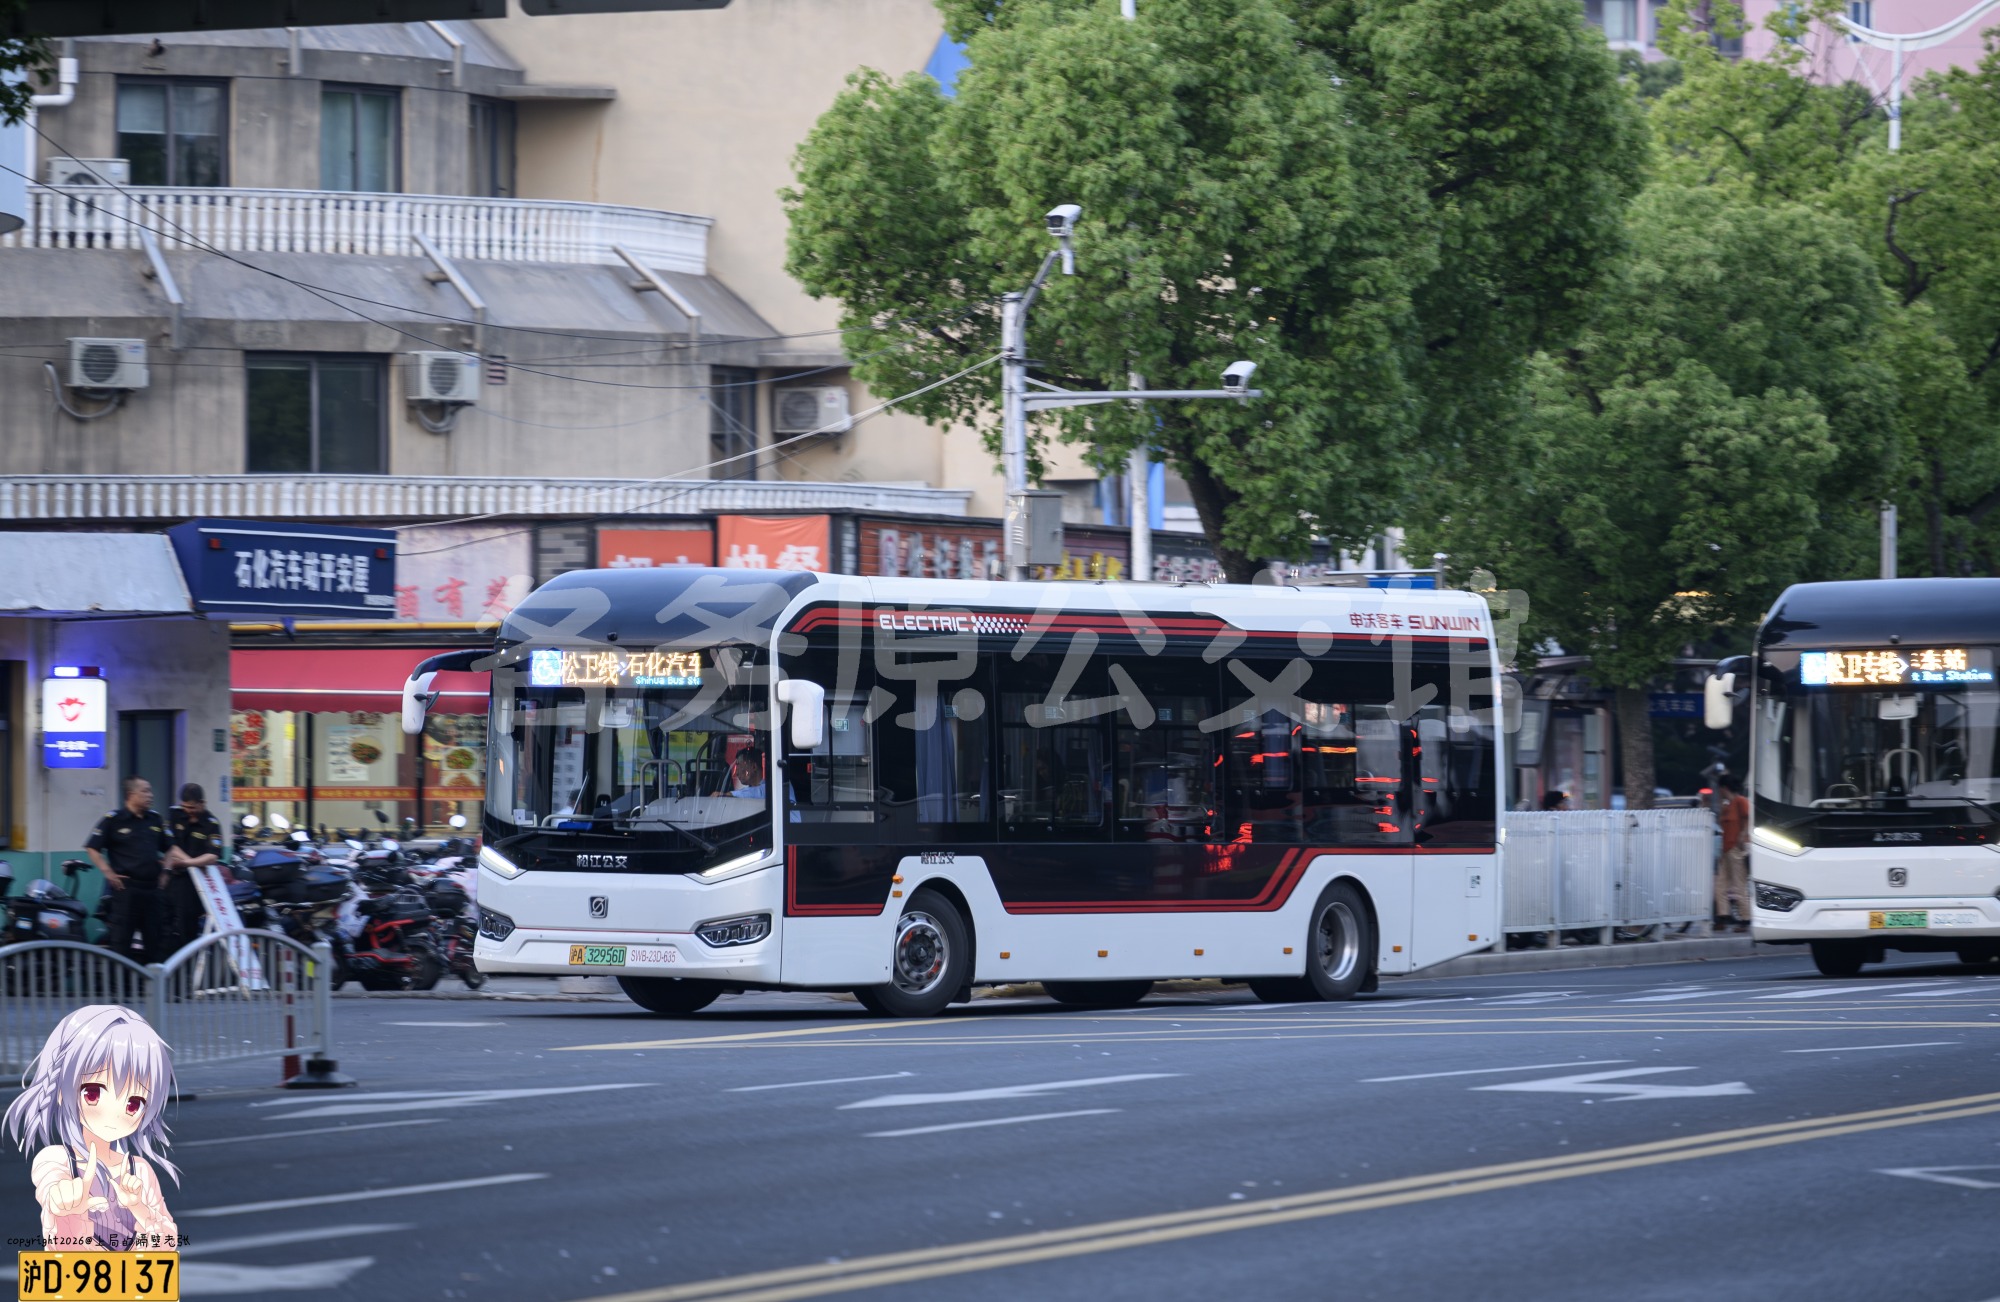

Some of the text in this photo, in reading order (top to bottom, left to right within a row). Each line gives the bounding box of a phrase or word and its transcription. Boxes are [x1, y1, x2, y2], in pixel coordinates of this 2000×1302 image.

[235, 549, 370, 593] 石化汽车站平安屋
[880, 614, 969, 632] ELECTRIC
[1350, 612, 1481, 631] 申沃客车 SUNWIN
[636, 675, 665, 685] Shihua
[667, 675, 685, 685] Bus
[577, 854, 628, 868] 松江公交
[631, 949, 676, 963] SWB-23D-635
